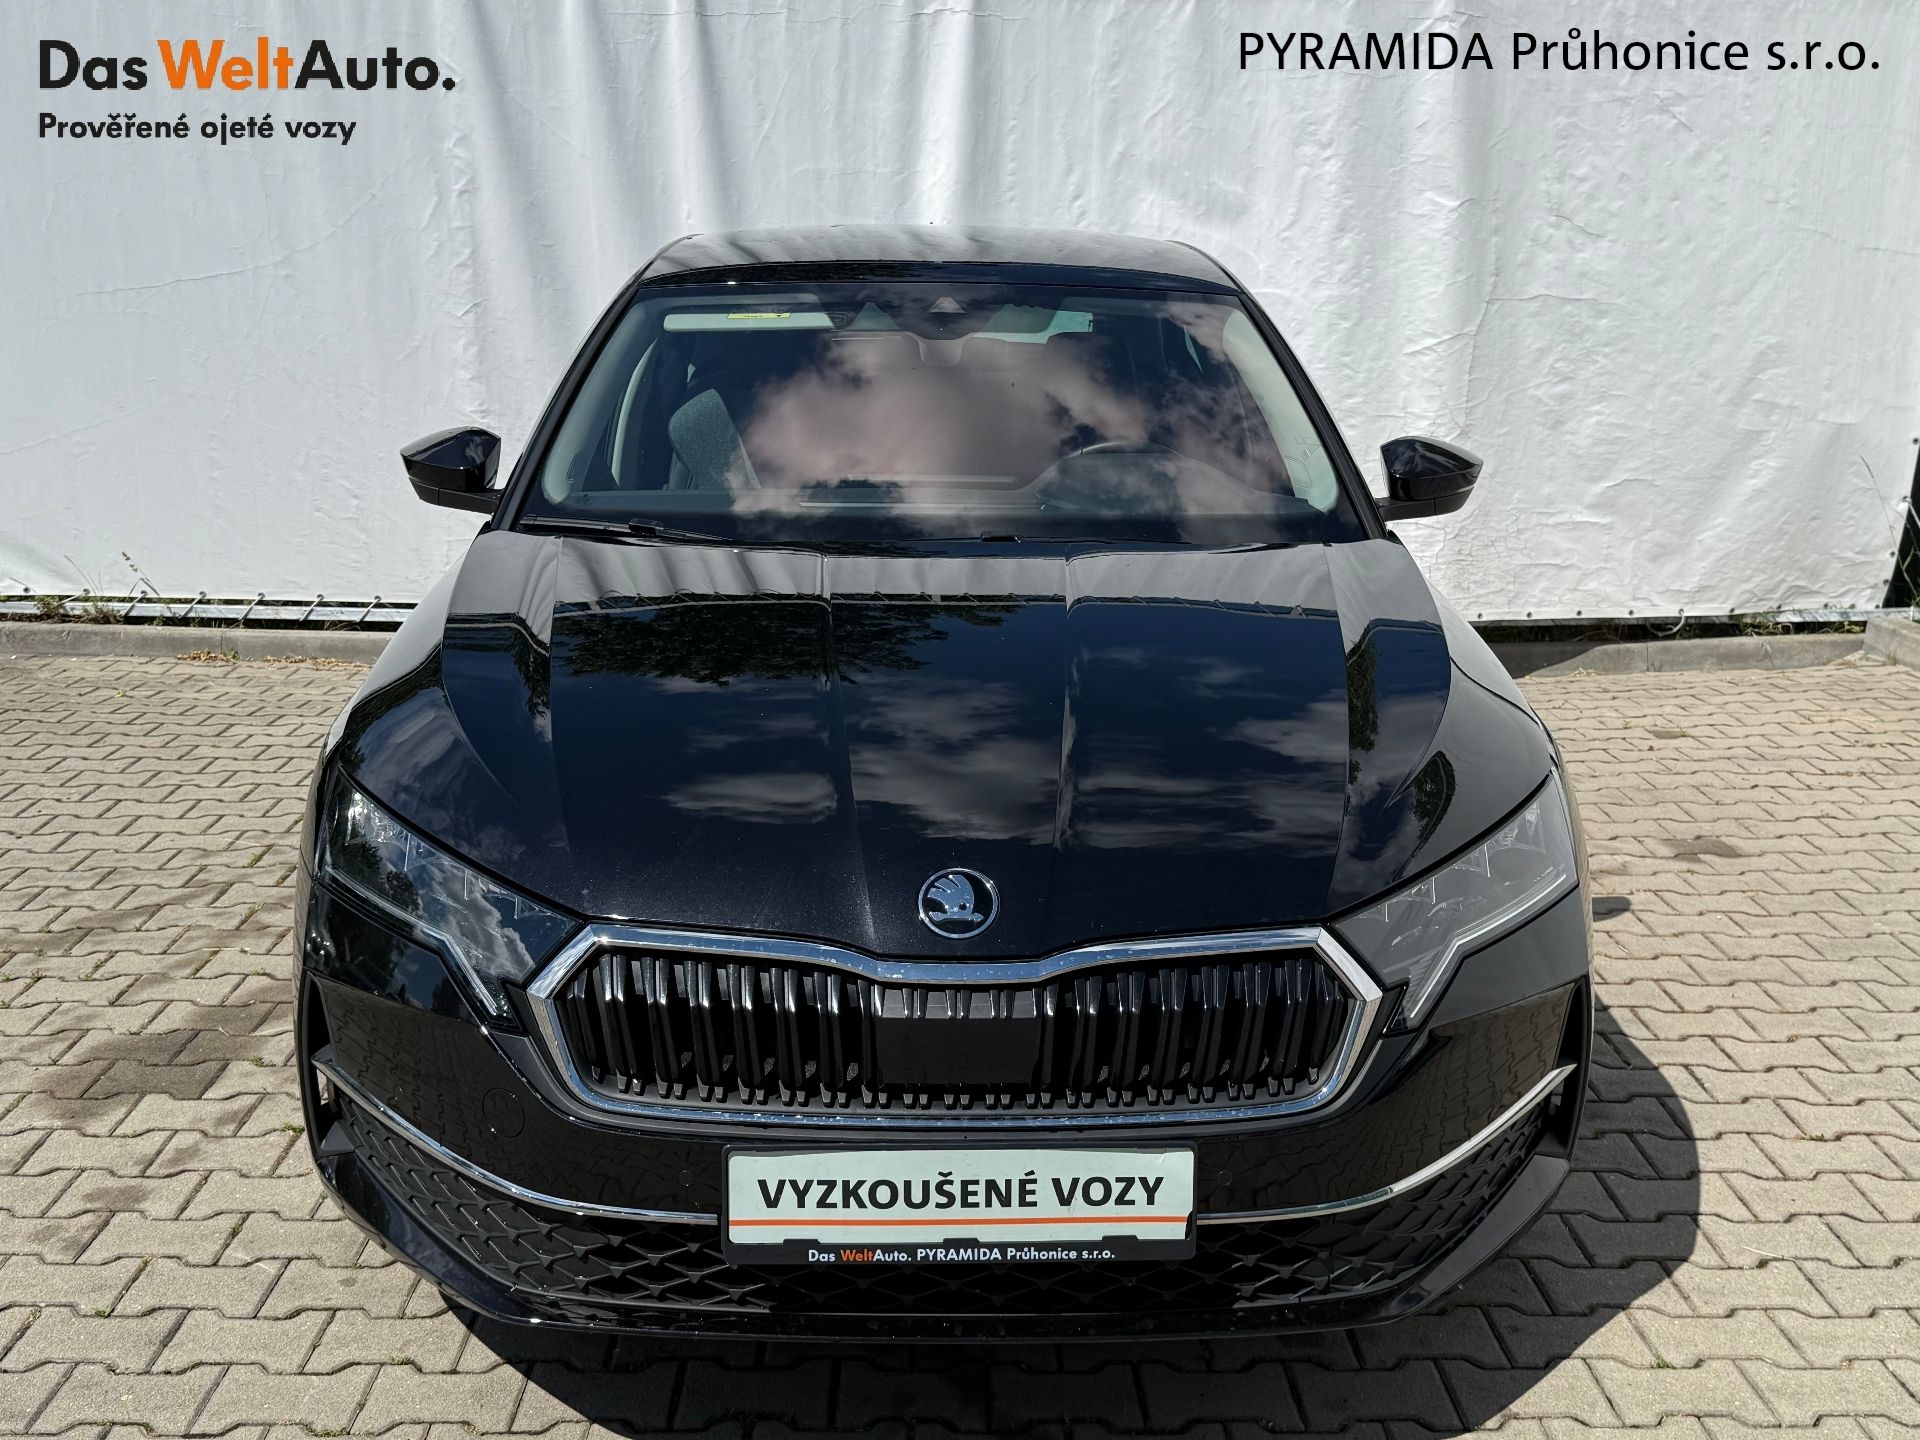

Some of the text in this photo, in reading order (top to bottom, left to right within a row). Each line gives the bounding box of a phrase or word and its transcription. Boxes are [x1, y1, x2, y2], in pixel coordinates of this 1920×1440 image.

[757, 1169, 1165, 1210] VYZKOUŠENÉ VOZY
[808, 1245, 1116, 1262] Das WeltAuto. PYRAMIDA Průhonice s.r.o.
